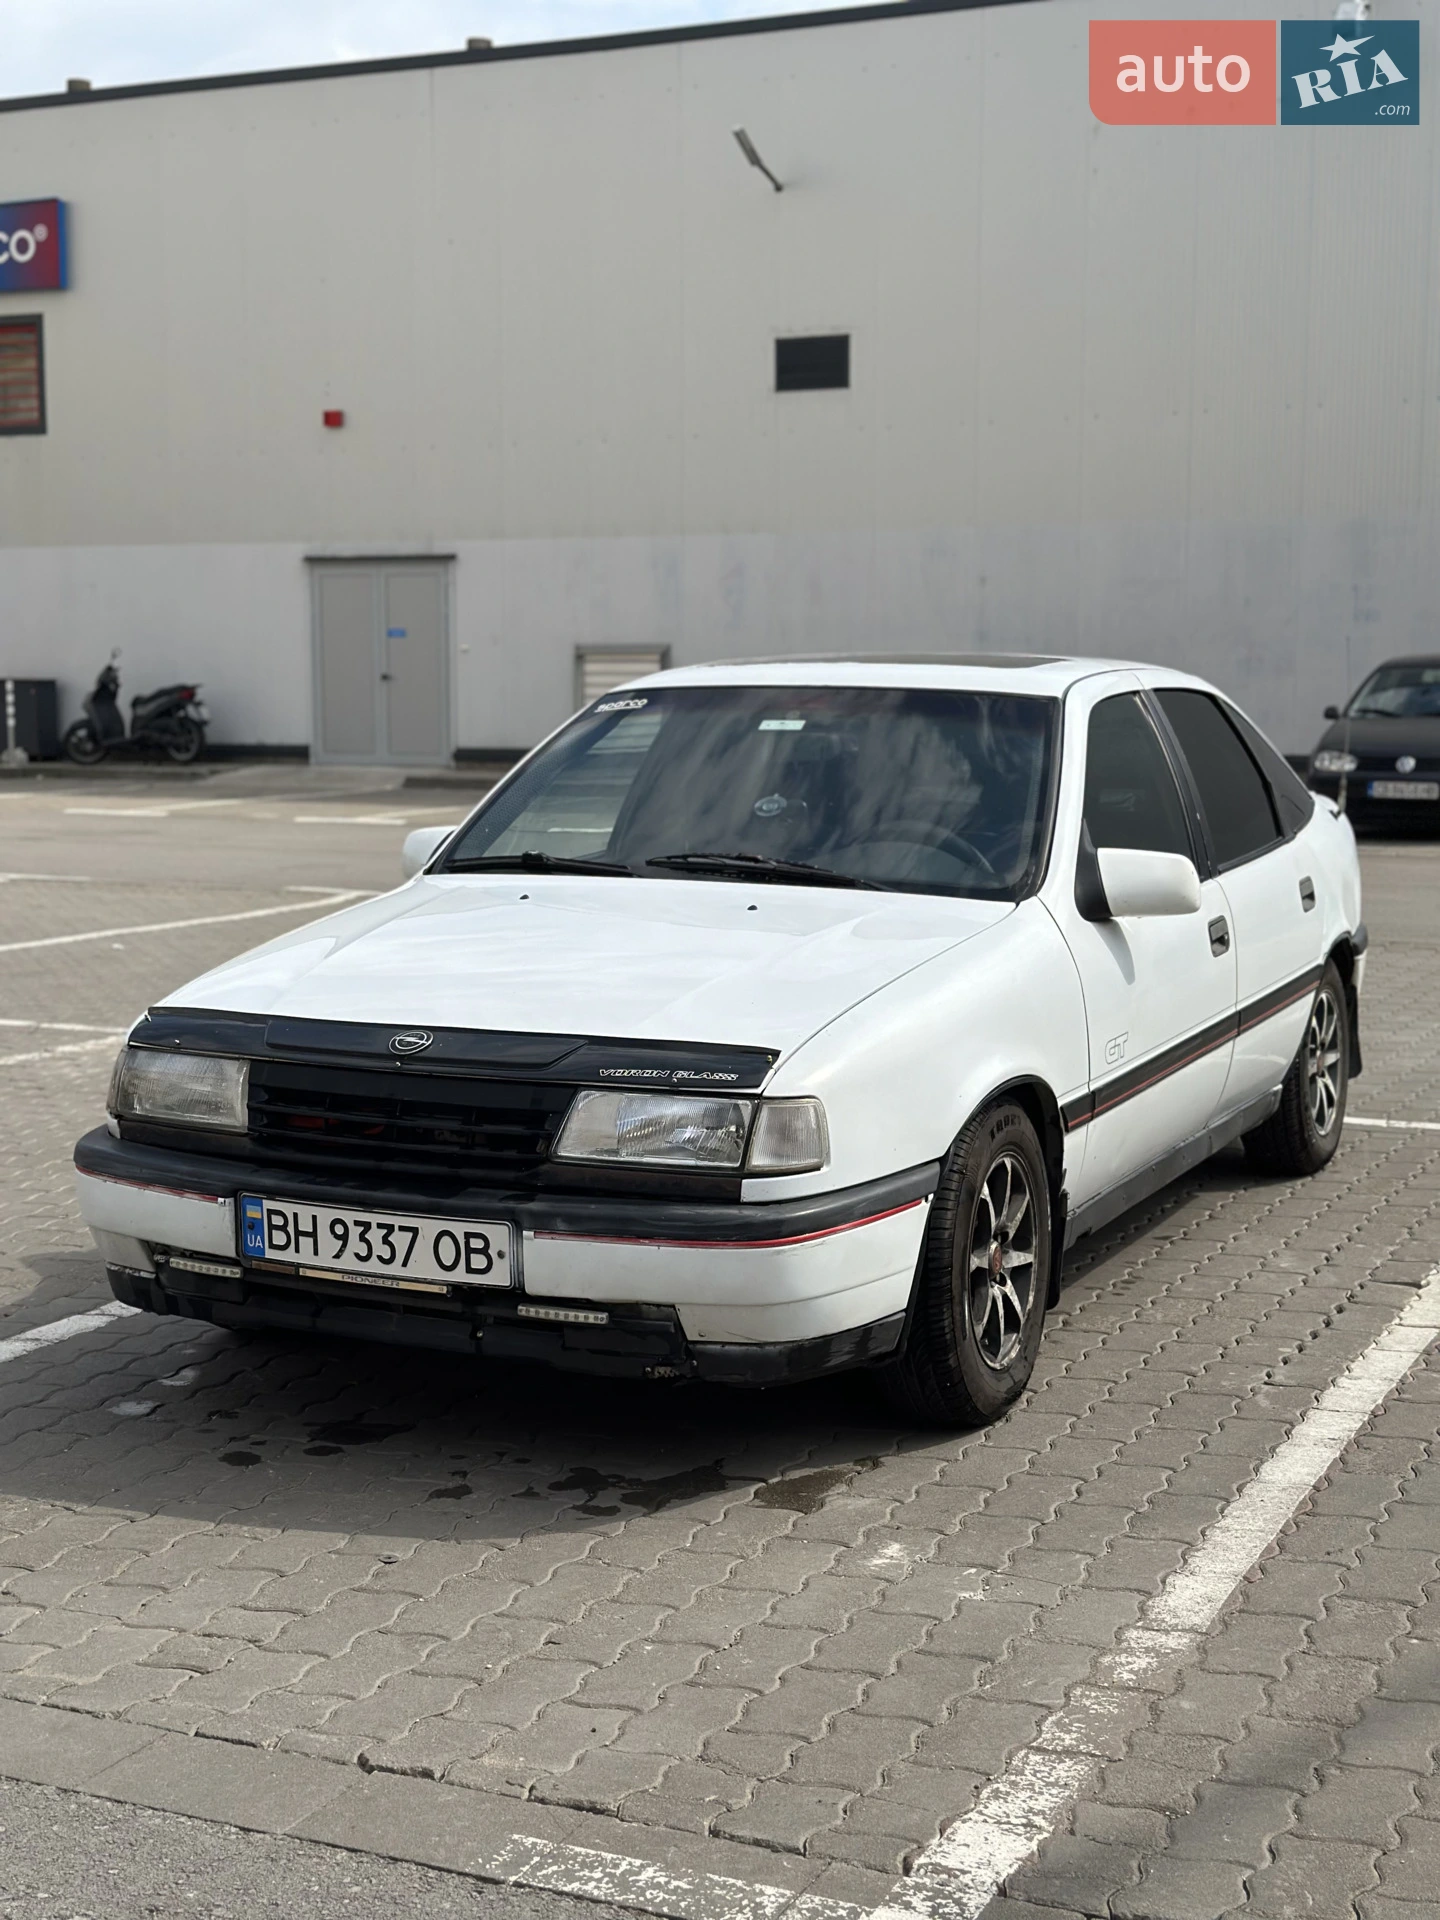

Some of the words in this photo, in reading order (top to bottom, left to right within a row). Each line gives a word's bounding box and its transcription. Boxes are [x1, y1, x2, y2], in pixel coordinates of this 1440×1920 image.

[1105, 1031, 1128, 1065] GT
[599, 1069, 670, 1078] VORON
[672, 1070, 739, 1081] GLASS
[247, 1233, 264, 1249] UA
[266, 1208, 319, 1257] BH
[329, 1217, 420, 1268] 9337
[433, 1229, 494, 1275] OB
[341, 1274, 400, 1287] PIONEER
